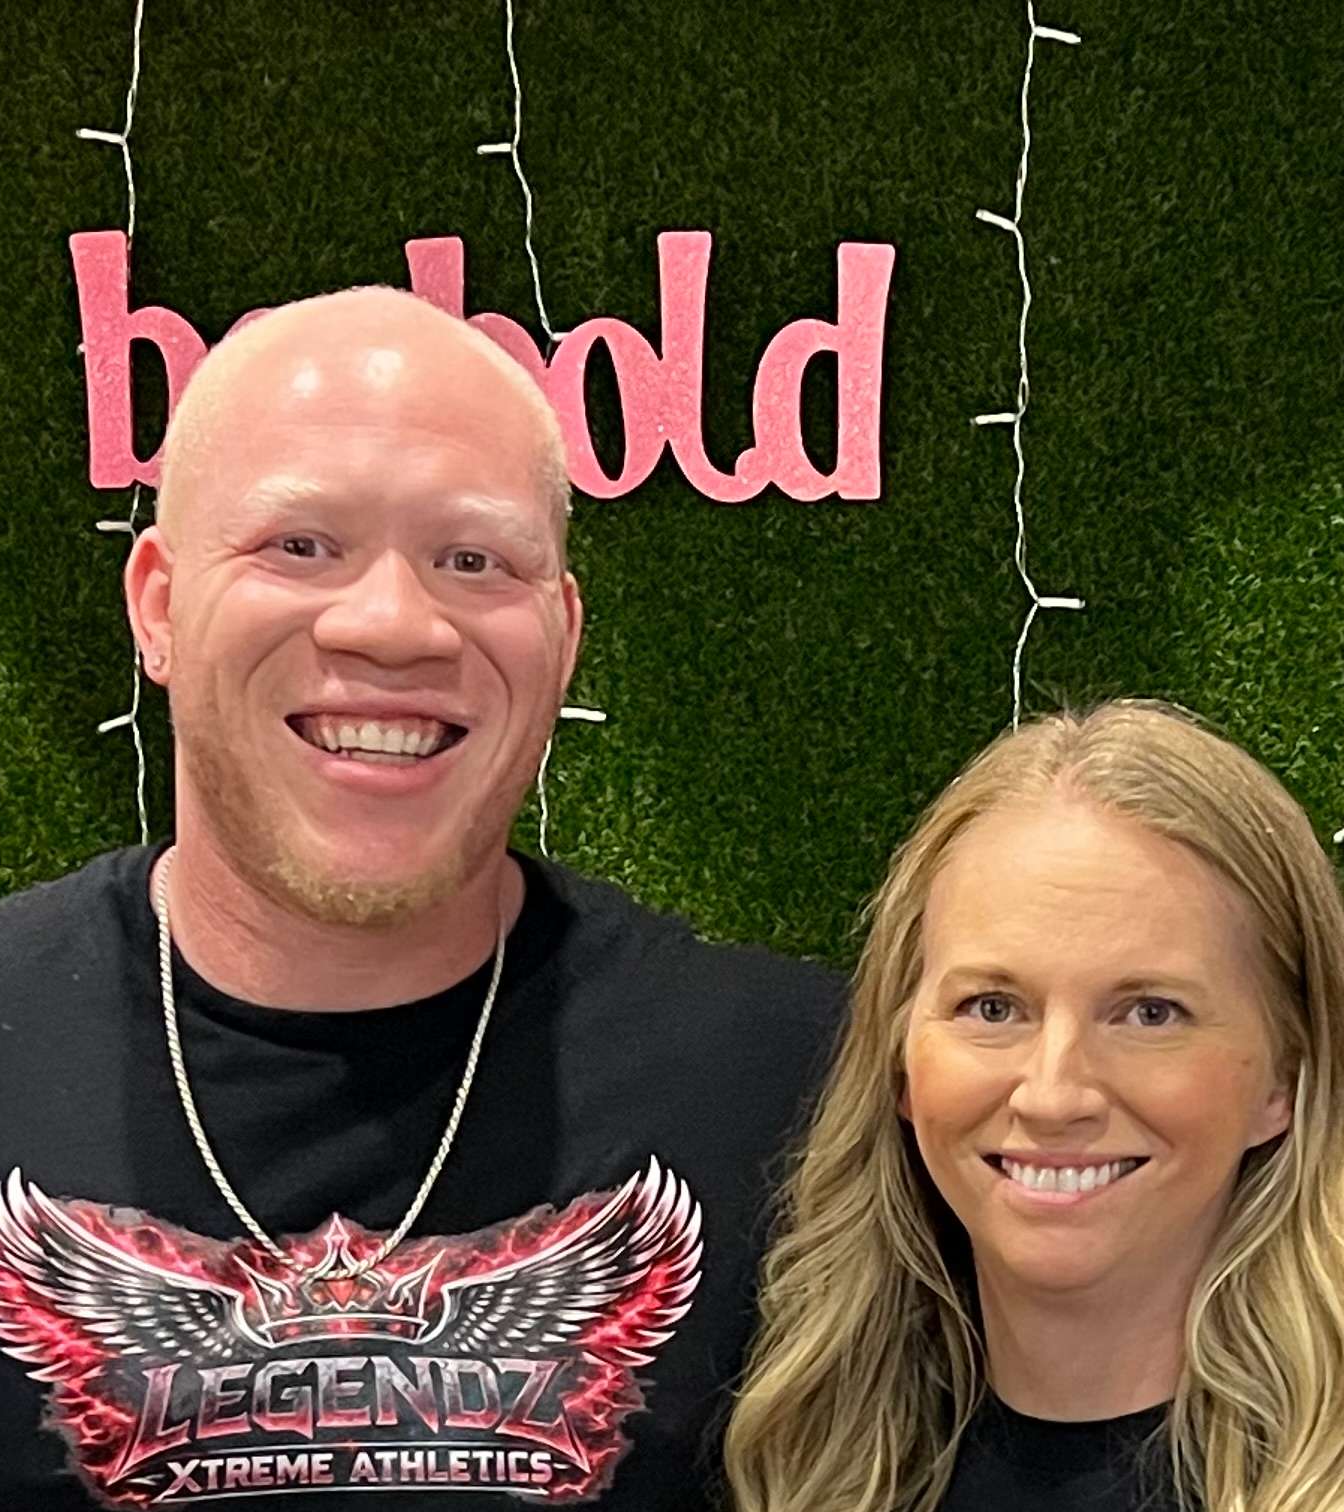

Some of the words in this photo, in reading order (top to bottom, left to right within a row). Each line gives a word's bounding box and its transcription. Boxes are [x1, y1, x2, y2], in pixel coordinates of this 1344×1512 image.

[69, 230, 274, 489] b
[106, 1356, 591, 1487] LEGENDZ
[166, 1453, 334, 1494] XTREME
[349, 1450, 552, 1485] ATHLETICS
